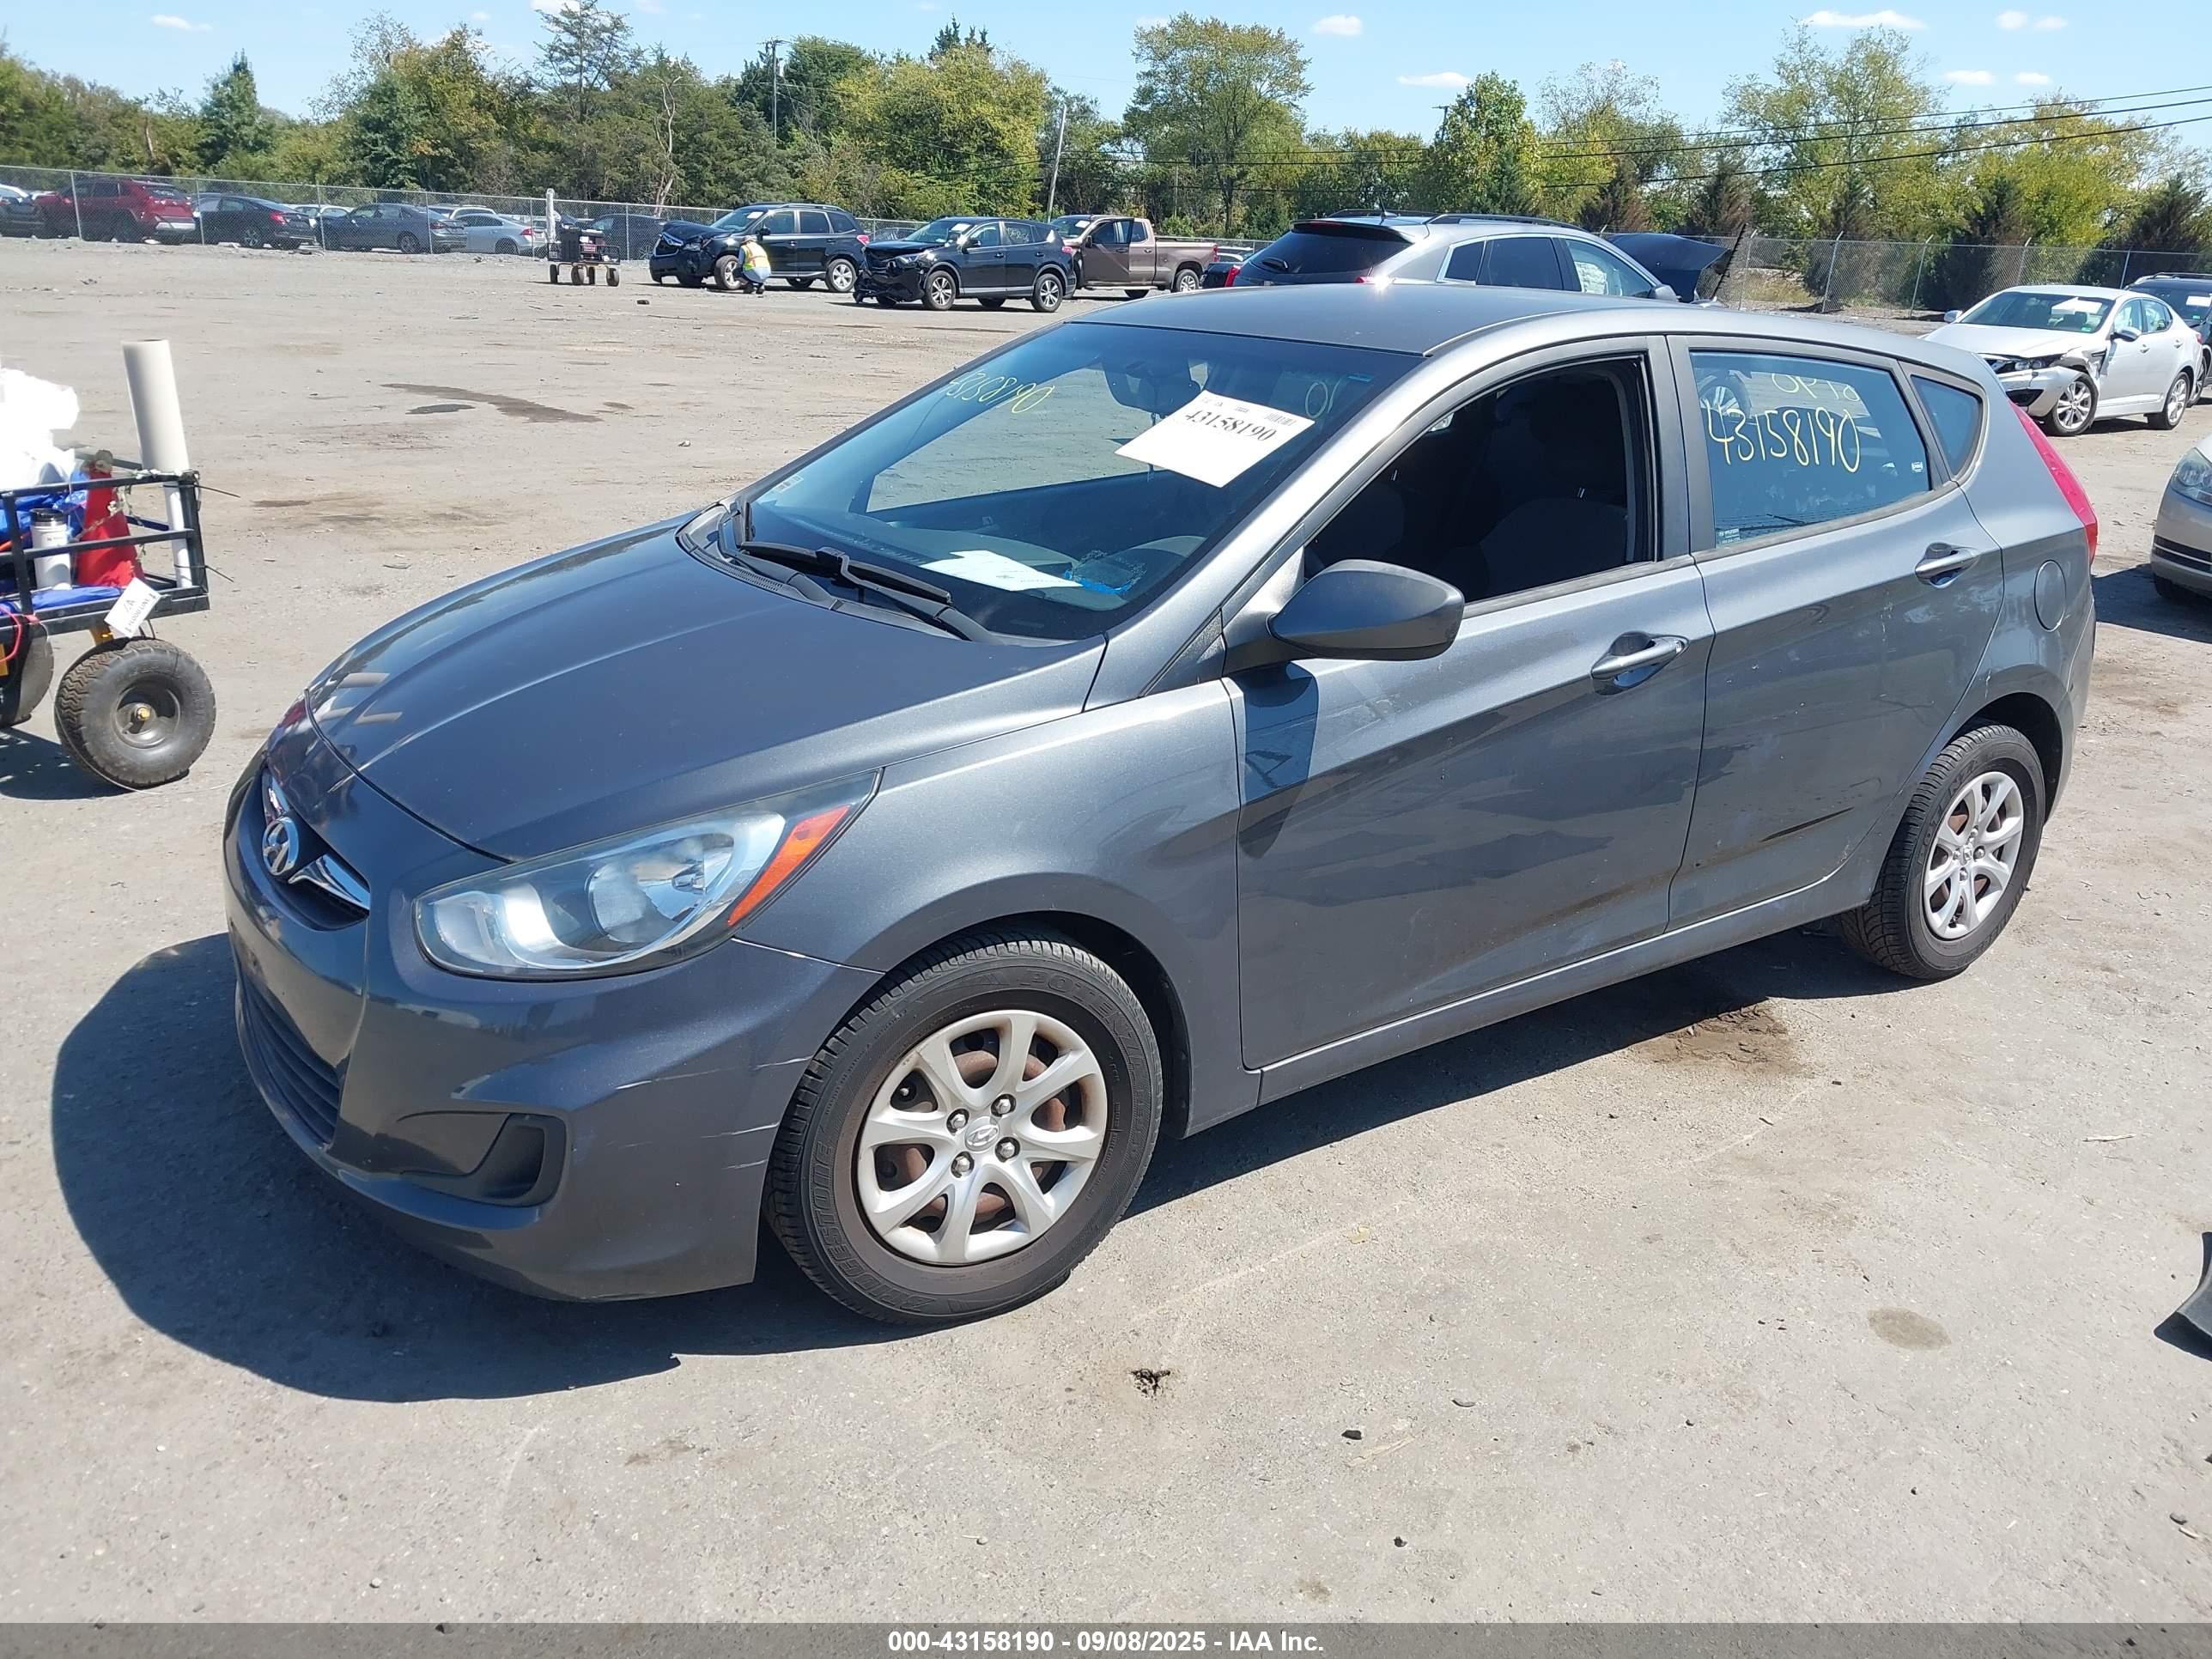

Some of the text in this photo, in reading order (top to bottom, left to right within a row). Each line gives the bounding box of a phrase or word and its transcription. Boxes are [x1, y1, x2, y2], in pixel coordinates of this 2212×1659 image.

[1185, 409, 1278, 442] 43158190
[1705, 401, 1860, 473] 43158190
[811, 1140, 936, 1313] BRIDGESTONE
